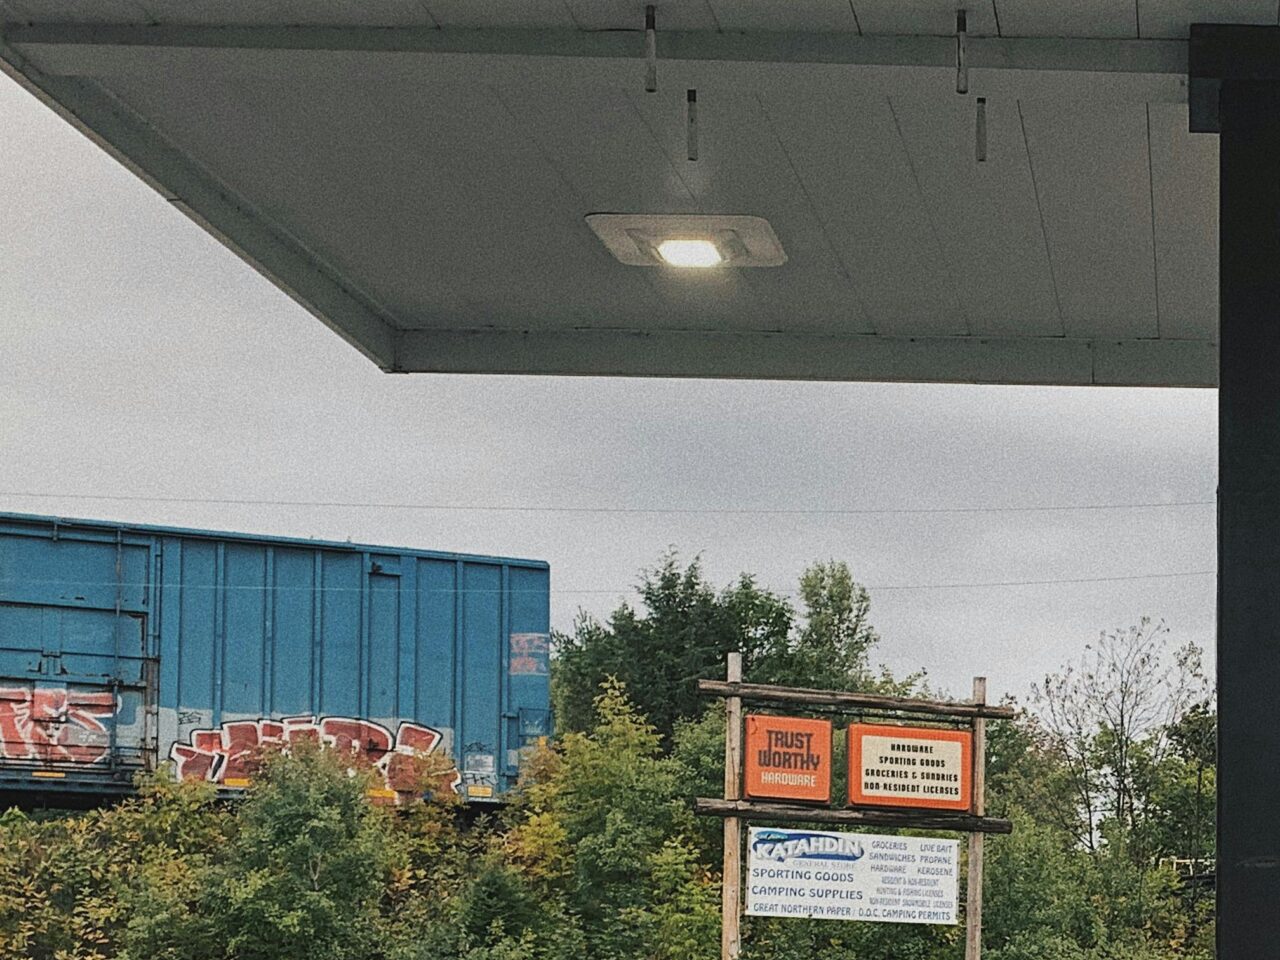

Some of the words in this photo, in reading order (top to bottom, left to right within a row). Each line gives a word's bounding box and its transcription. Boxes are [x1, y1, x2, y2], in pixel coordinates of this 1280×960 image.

[766, 729, 814, 750] TRUST
[890, 744, 934, 754] HARDWARE
[758, 750, 820, 771] WORTHY
[879, 756, 916, 766] SPORTING
[920, 758, 946, 768] GOODS
[761, 771, 816, 787] HARDWARE
[865, 768, 908, 779] GROCERIES
[920, 772, 958, 782] SUNDRIES
[923, 785, 959, 795] LICENSES
[756, 836, 859, 860] KATAHDIN
[872, 840, 908, 850] GROCERIES
[920, 843, 934, 852] LIVE
[936, 844, 952, 853] BAIT
[869, 852, 916, 862] SANDWICHES
[920, 856, 952, 864] PROPANE
[752, 868, 811, 880] SPORTING
[814, 872, 854, 882] GOODS
[870, 864, 907, 874] HARDWARE
[918, 866, 953, 876] KEROSENE
[752, 885, 806, 897] CAMPING
[809, 888, 863, 900] SUPPLIES
[754, 902, 778, 912] GREAT
[781, 904, 824, 914] NORTHERN
[826, 906, 852, 916] PAPER
[882, 909, 916, 919] CAMPING
[918, 910, 951, 920] PERMITS
